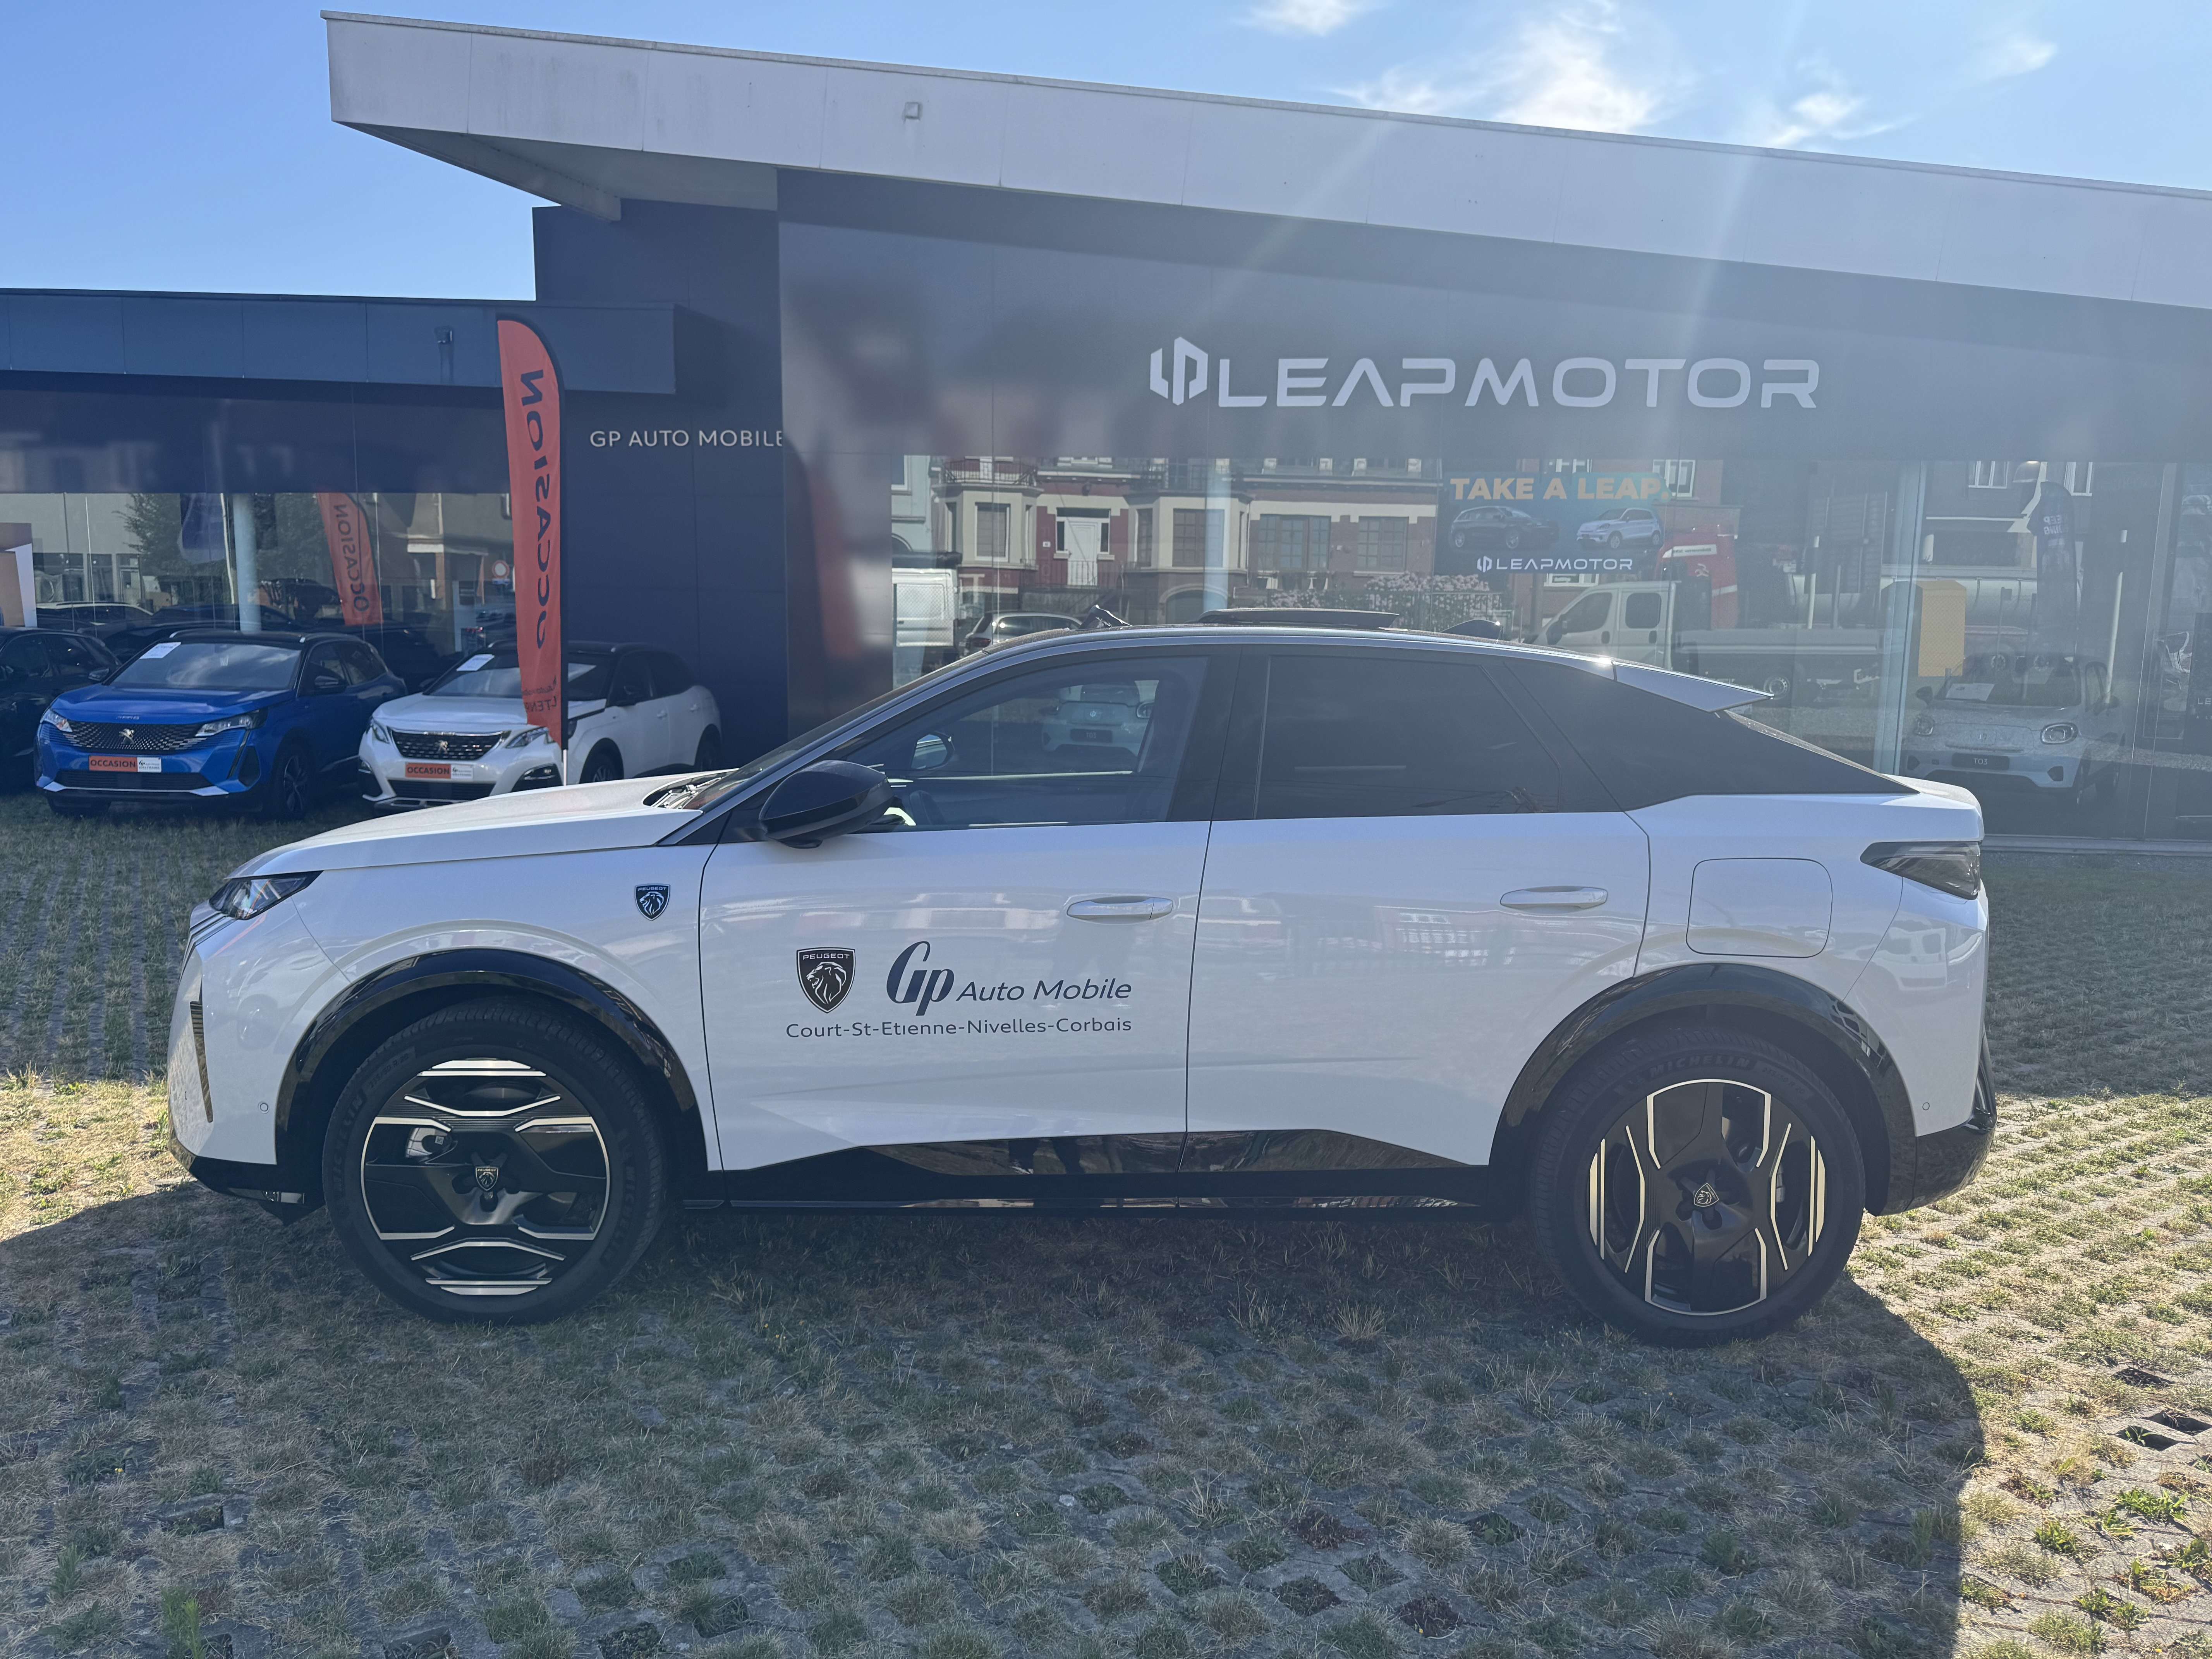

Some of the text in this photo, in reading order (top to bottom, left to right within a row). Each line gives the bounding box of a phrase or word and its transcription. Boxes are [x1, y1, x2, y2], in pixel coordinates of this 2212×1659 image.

[1218, 357, 1820, 409] LEAPMOTOR
[590, 430, 621, 447] GP
[629, 430, 689, 447] AUTO
[1450, 478, 1534, 500] TAKE
[1543, 478, 1567, 500] A
[1496, 558, 1633, 570] LEAPMOTOR
[90, 759, 136, 768] OCCASION
[956, 981, 1025, 1001] Auto
[1033, 978, 1132, 1001] Mobile
[1649, 1055, 1750, 1078] MICHELIN
